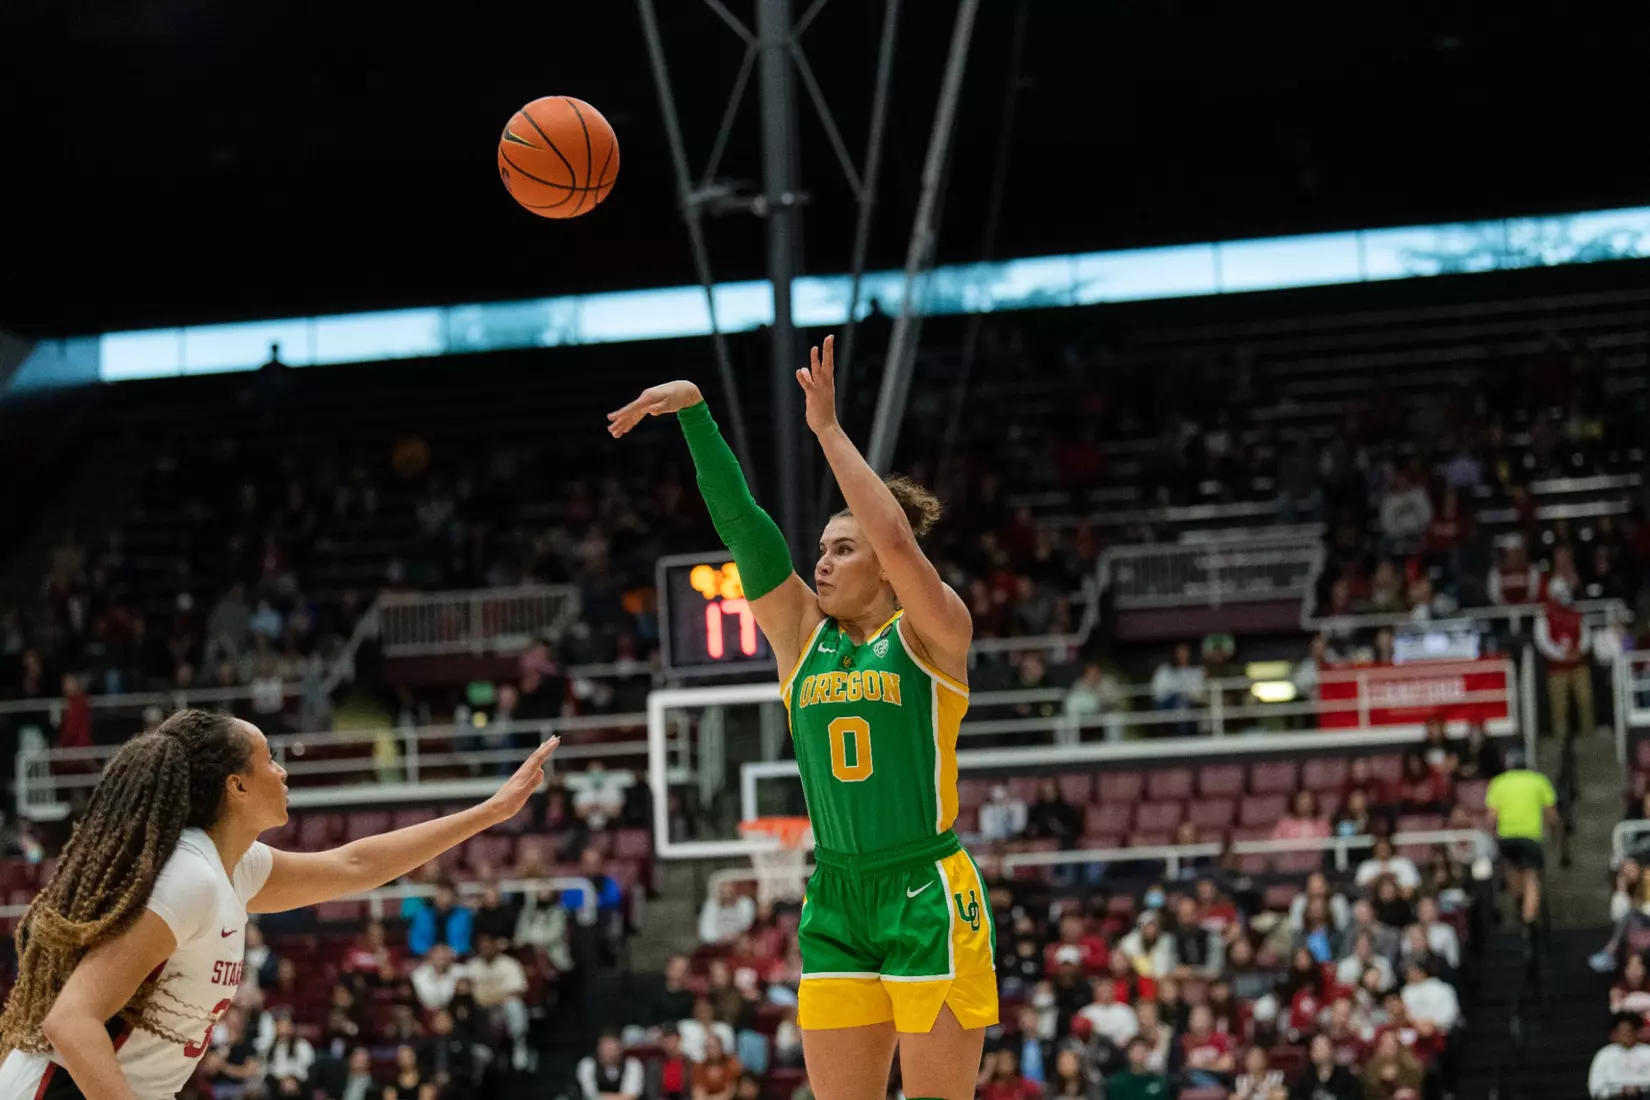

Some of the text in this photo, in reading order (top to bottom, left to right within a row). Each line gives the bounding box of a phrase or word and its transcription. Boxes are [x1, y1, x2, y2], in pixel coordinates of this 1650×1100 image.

[706, 598, 757, 659] 17
[799, 669, 902, 708] OREGON
[828, 716, 873, 782] 0
